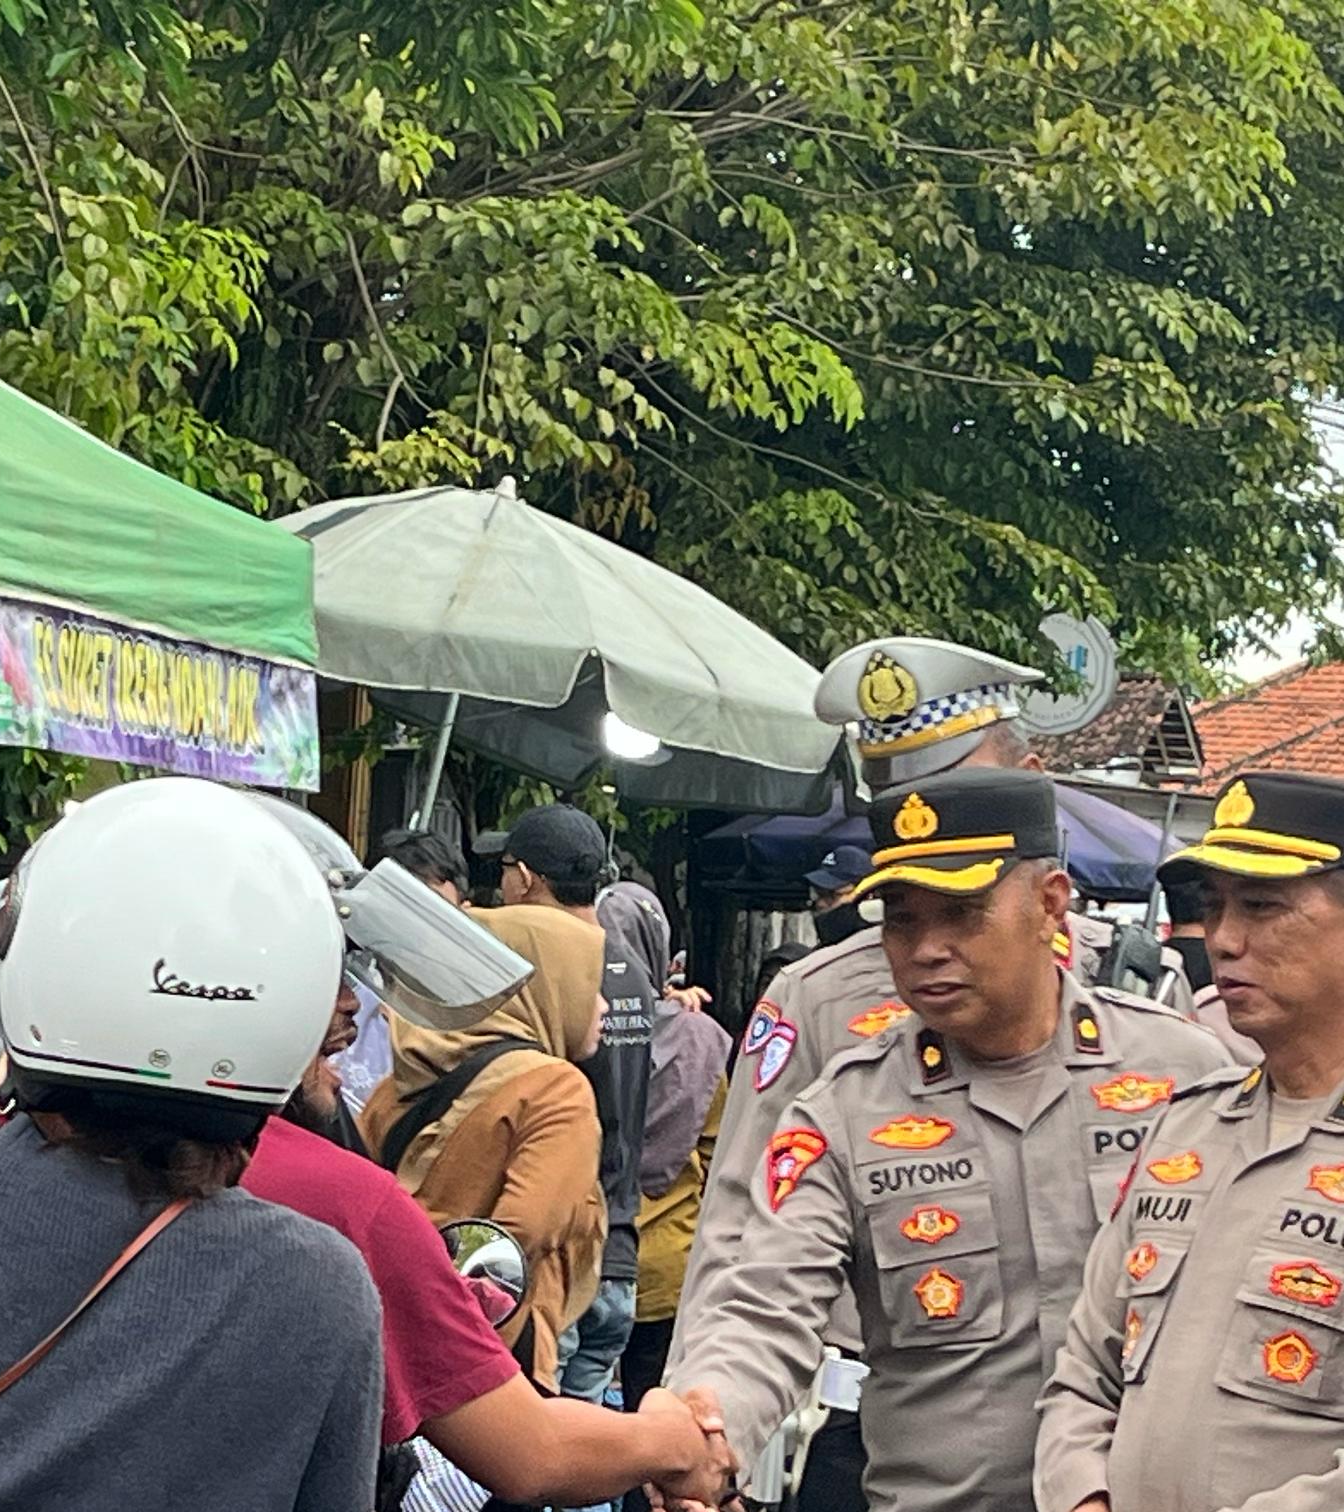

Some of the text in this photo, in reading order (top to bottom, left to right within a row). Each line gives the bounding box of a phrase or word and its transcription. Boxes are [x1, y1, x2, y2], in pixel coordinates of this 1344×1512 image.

[148, 957, 258, 1001] Vespa
[868, 1158, 973, 1195] SUYONO
[1135, 1196, 1193, 1222] MUJI
